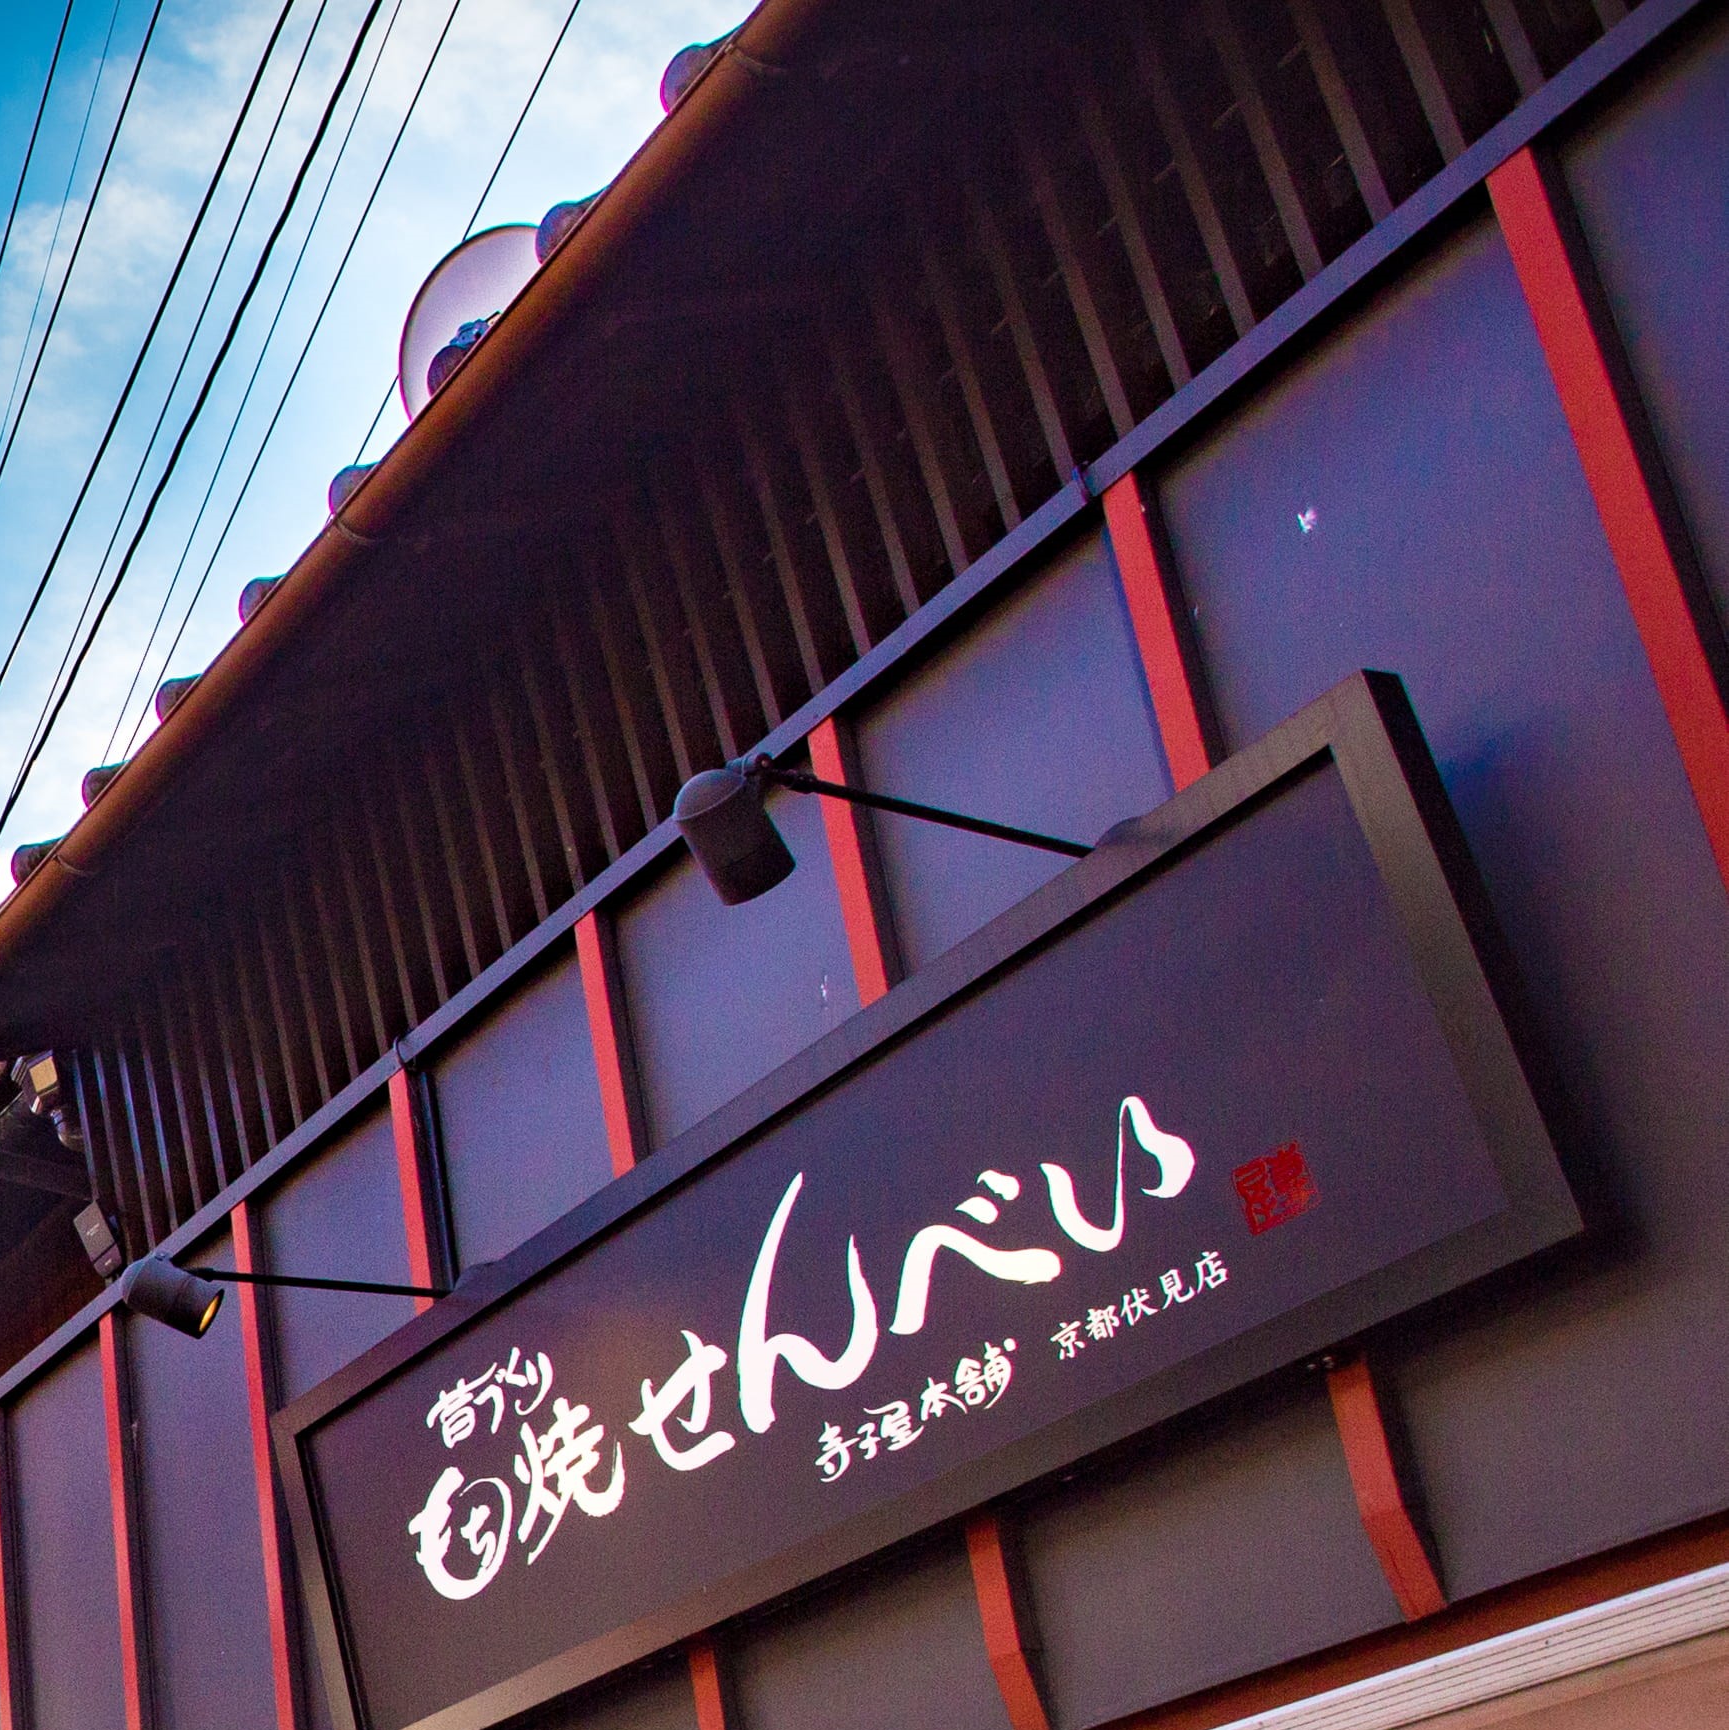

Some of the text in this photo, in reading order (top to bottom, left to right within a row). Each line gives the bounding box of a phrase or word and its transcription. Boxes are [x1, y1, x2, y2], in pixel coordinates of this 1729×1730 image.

[1049, 1251, 1230, 1361] 京都伏見店
[426, 1348, 553, 1446] 昔づくり
[814, 1339, 1019, 1483] 寺子屋本舗
